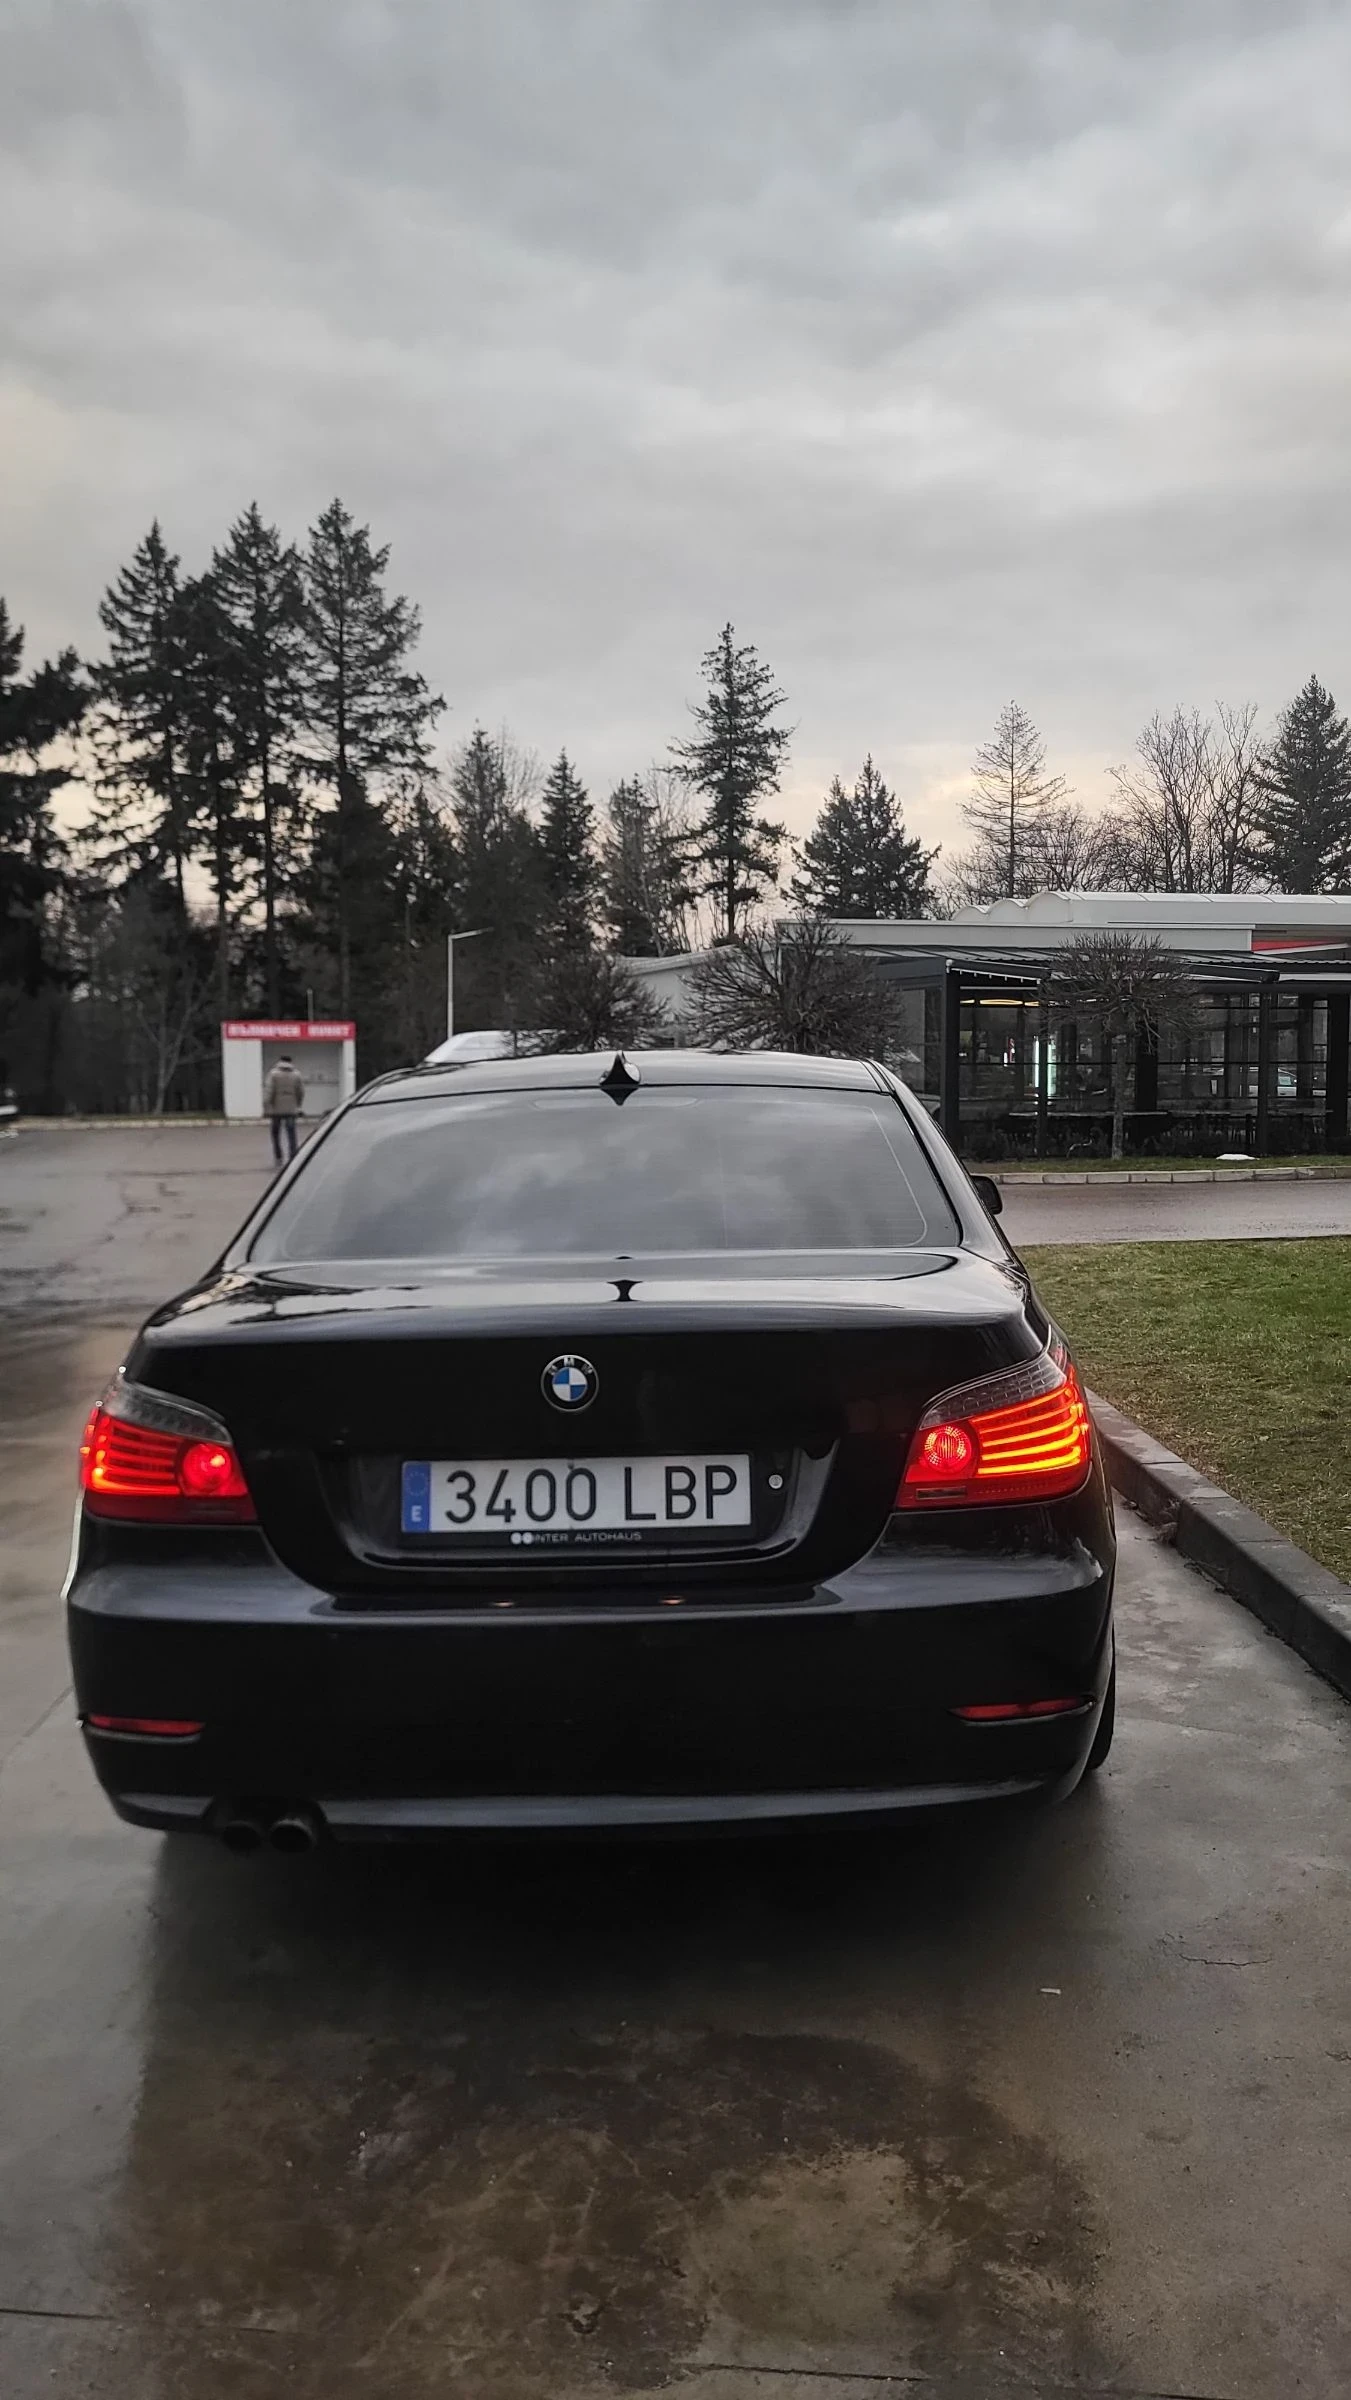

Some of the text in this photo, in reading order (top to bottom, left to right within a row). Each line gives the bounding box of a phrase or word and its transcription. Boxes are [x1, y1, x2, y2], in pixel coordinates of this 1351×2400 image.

[548, 1356, 593, 1376] BMW
[445, 1464, 738, 1524] 3400 LBP
[410, 1505, 422, 1522] E
[574, 1531, 642, 1543] AUTOHAUS
